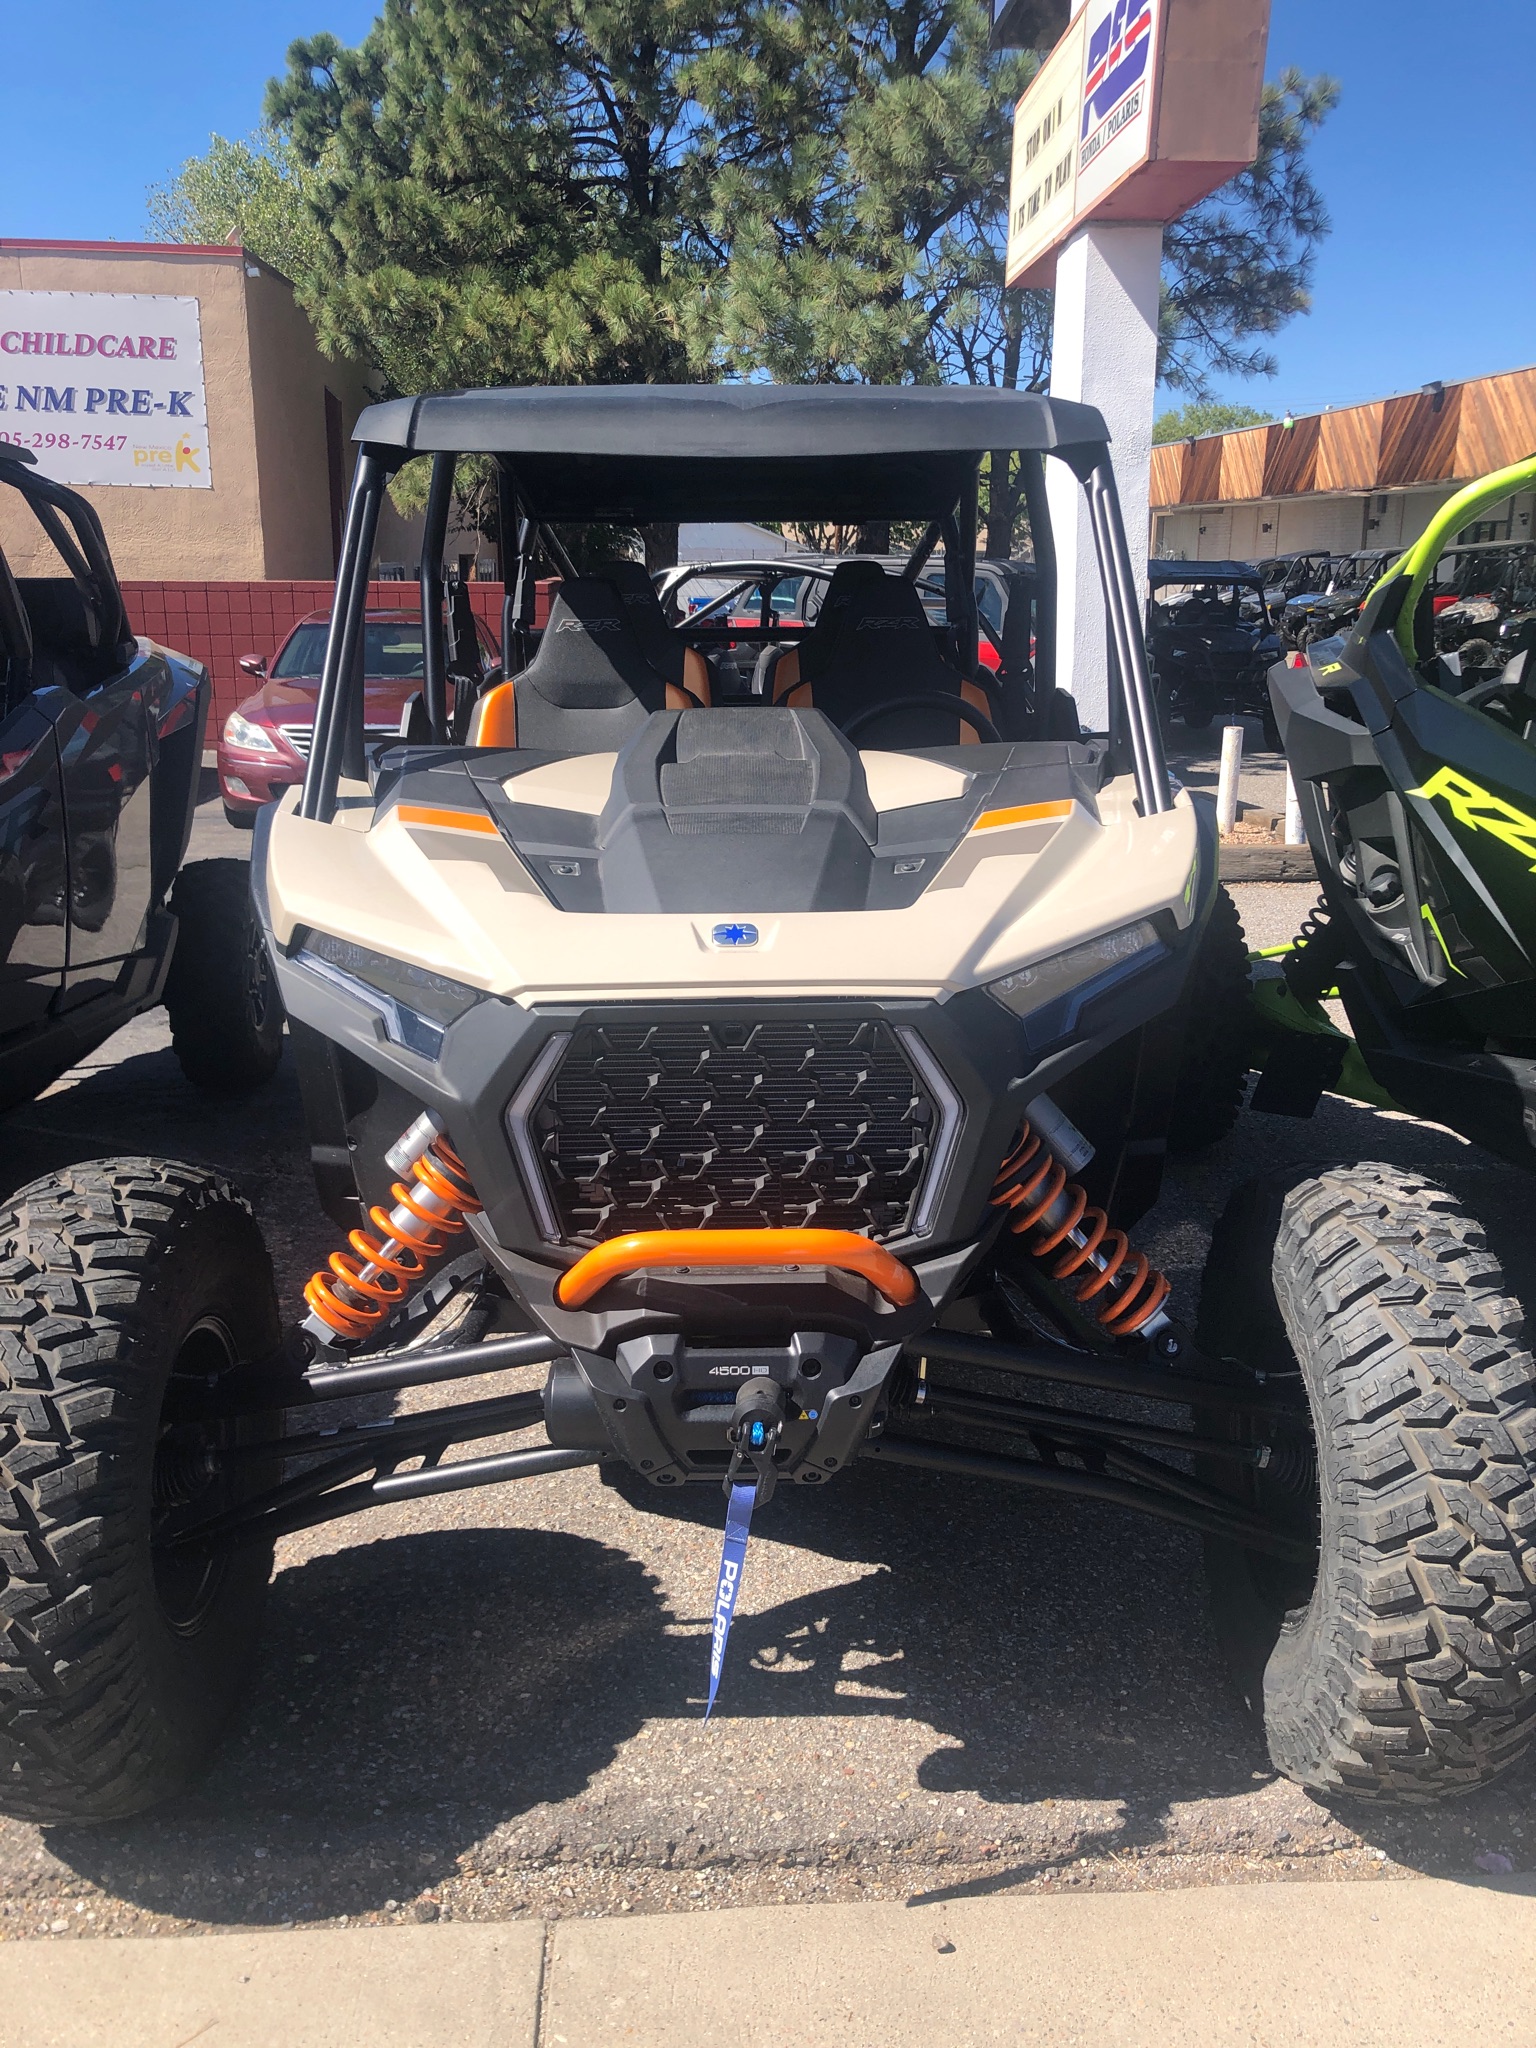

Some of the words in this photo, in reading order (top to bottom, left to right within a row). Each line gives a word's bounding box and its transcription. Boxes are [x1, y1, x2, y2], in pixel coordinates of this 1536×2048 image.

[1107, 92, 1140, 139] POLARIS
[1026, 125, 1040, 167] STOP
[1027, 185, 1041, 223] TIME
[1044, 173, 1052, 206] TO
[1055, 148, 1072, 193] PLAY
[1, 331, 176, 359] CHILDCARE
[15, 385, 75, 412] NM
[84, 387, 193, 416] PRE-K
[556, 618, 621, 633] RZR
[856, 616, 920, 631] RZR
[1404, 766, 1536, 873] RZ
[708, 1365, 751, 1376] 4500
[752, 1365, 769, 1375] HD
[711, 1559, 739, 1680] POLARIS
